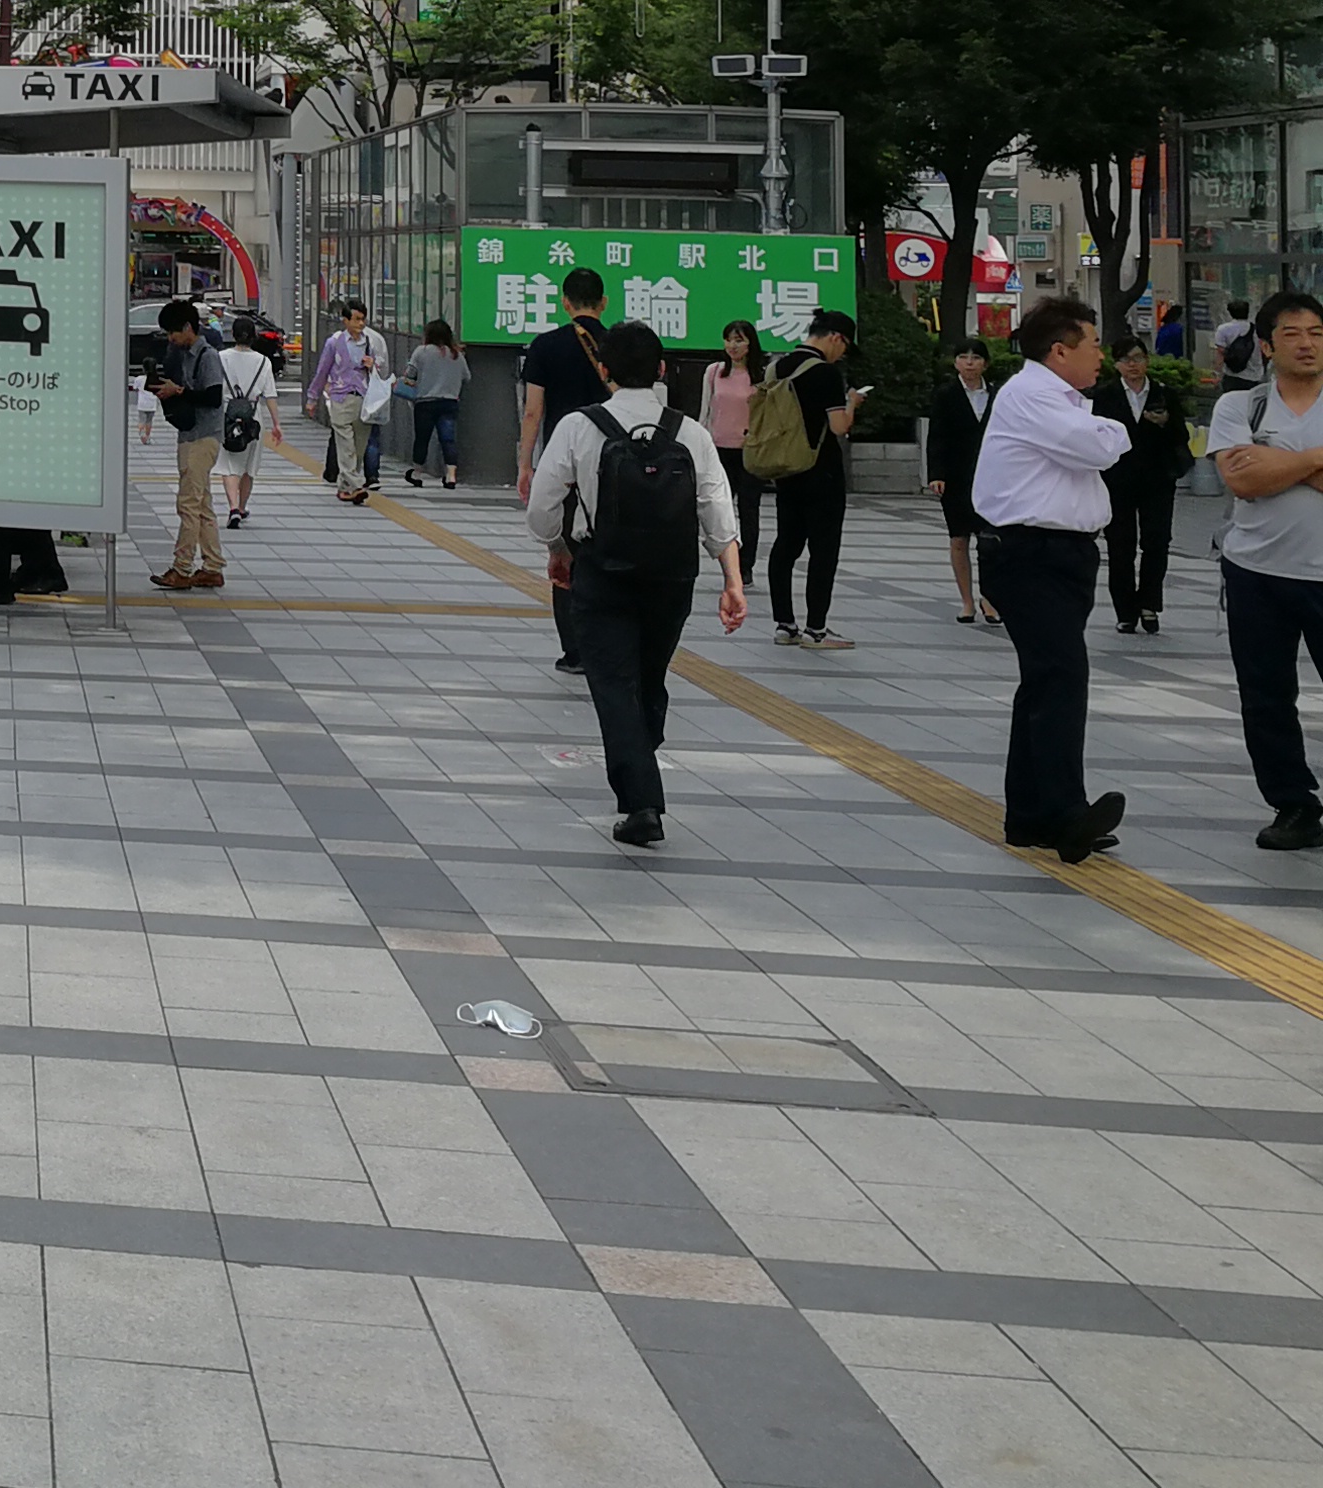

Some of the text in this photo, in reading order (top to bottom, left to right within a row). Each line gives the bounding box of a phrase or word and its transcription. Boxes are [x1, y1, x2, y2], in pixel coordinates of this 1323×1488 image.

[64, 73, 160, 102] TAXI
[477, 237, 839, 273] 錦糸町駅北口
[494, 272, 821, 343] 駐輪場
